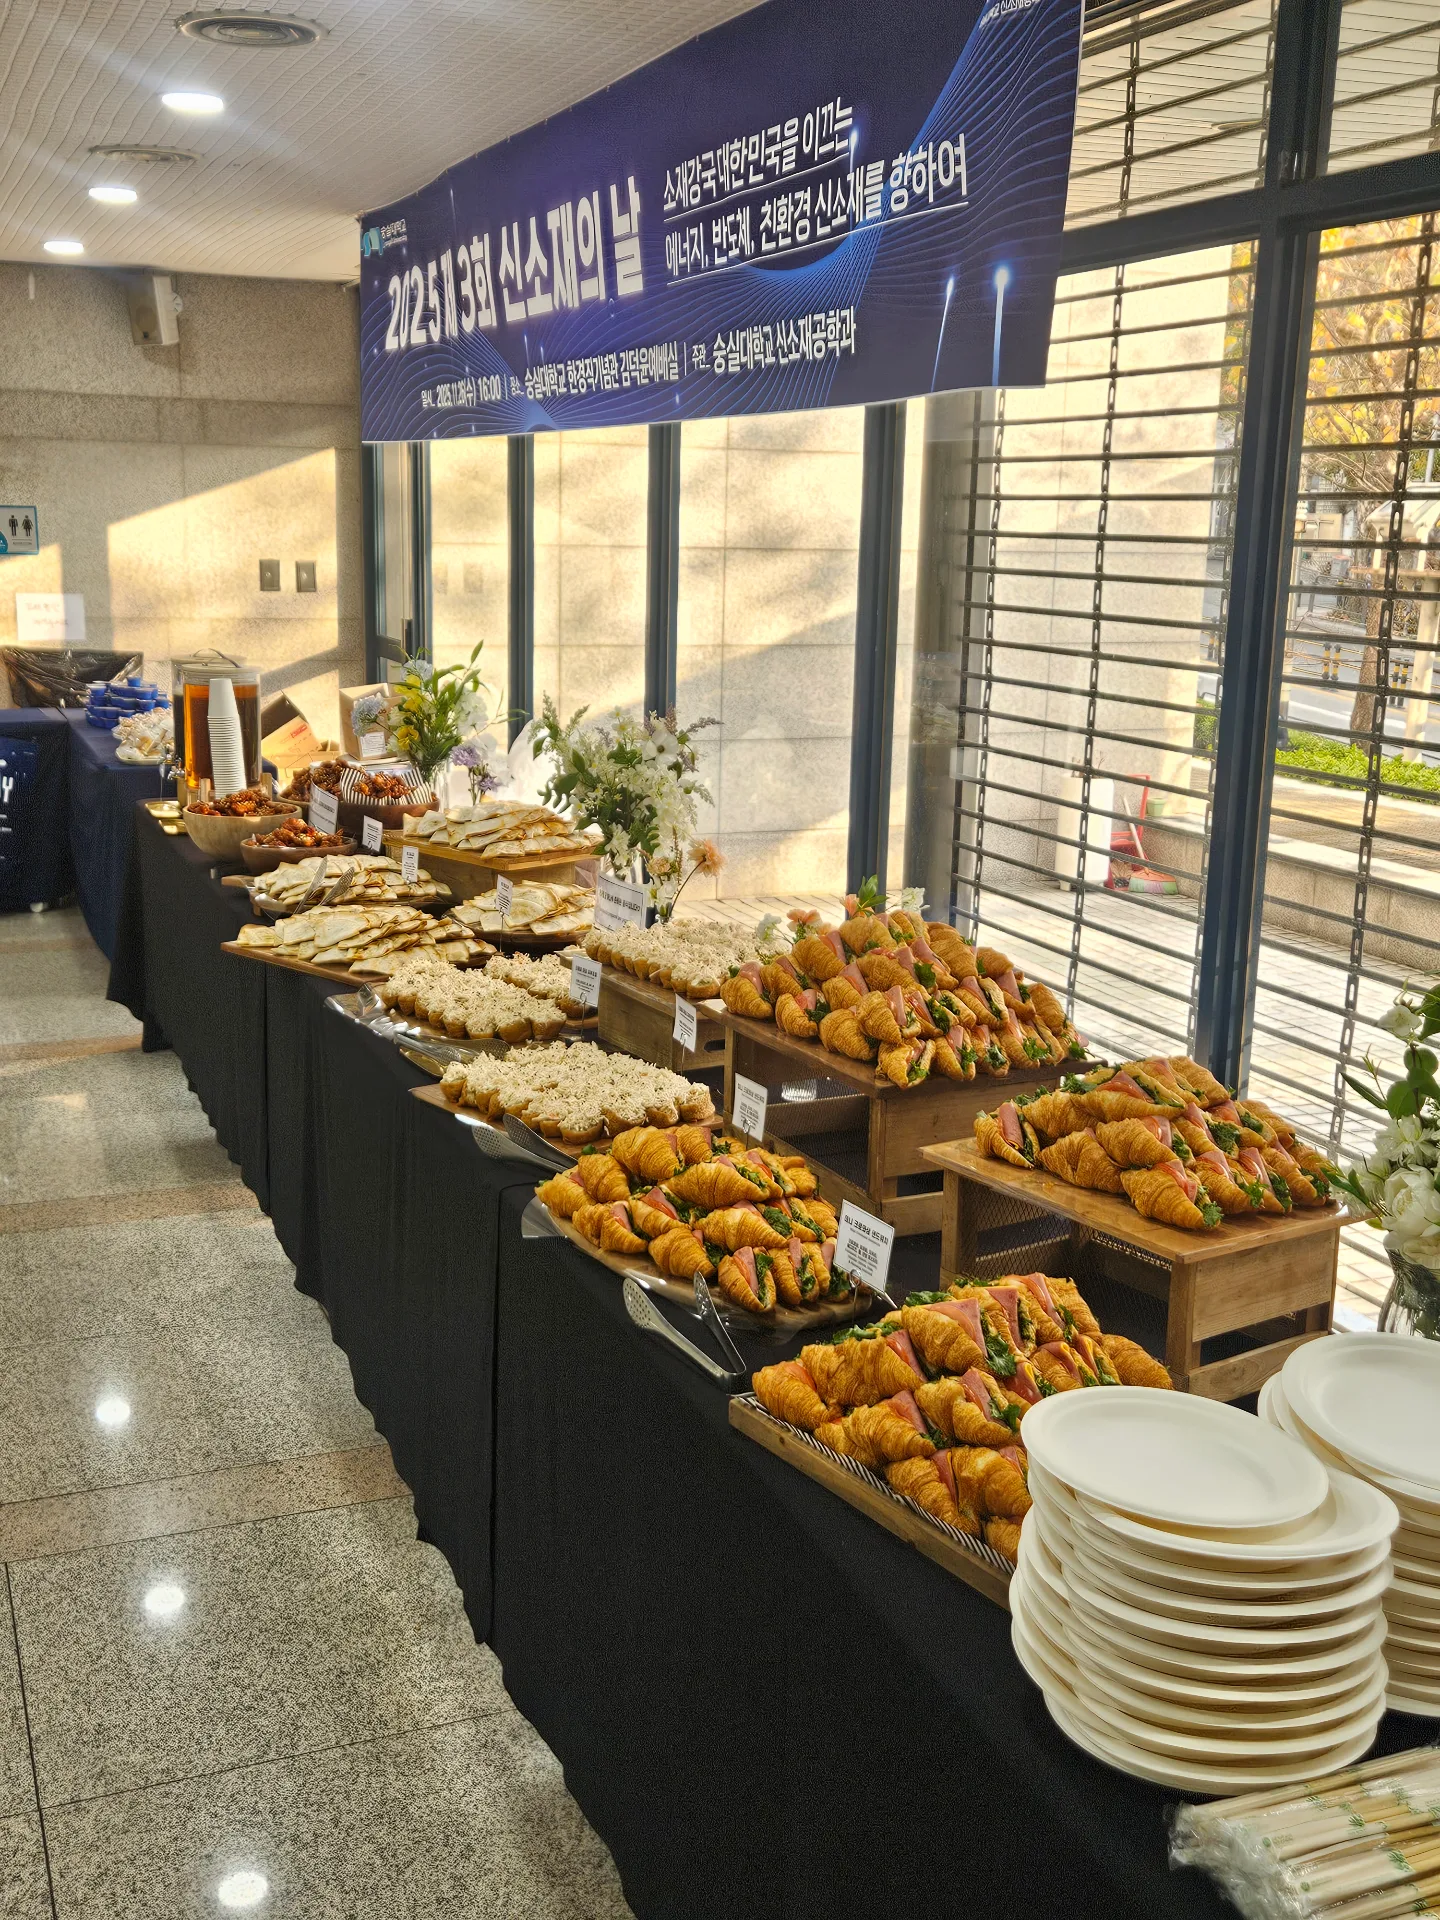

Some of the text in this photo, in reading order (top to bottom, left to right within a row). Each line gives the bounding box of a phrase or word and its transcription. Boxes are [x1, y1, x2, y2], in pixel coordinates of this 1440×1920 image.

[663, 96, 853, 211] 소재강국 대한민국을 이끄는
[665, 132, 968, 276] 에너지, 반도체, 친환경 신소재를 향하여
[499, 190, 606, 322] 신소재의
[609, 175, 643, 296] 날
[477, 374, 501, 401] 16:00
[524, 363, 568, 400] 숭실대학교
[566, 351, 620, 394] 한경직기념관
[619, 340, 679, 387] 김덕윤예배실
[712, 324, 776, 374] 숭실대학교
[776, 305, 857, 364] 신소재공학과
